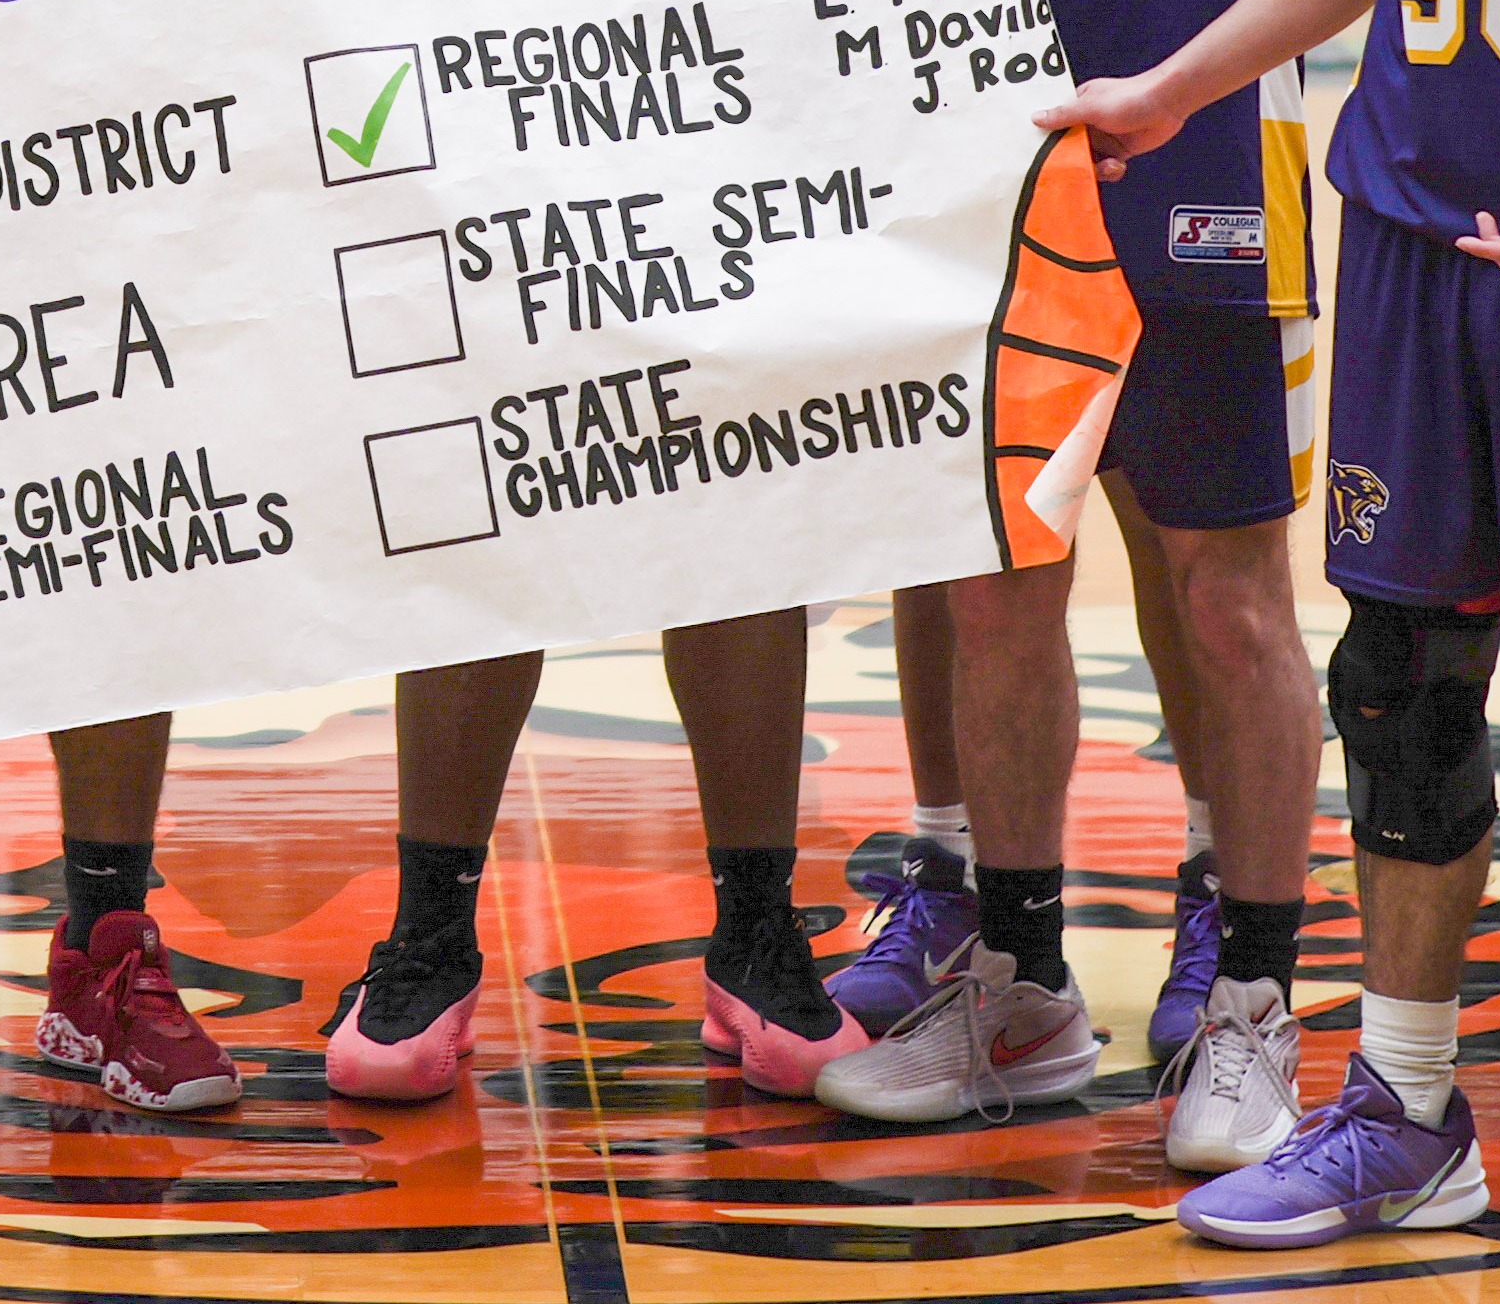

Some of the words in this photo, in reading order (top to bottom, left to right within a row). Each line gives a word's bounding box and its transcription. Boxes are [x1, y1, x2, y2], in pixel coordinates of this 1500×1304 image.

[433, 3, 743, 93] REGIONAL
[510, 64, 752, 151] FINALS
[455, 194, 674, 282] STATE
[712, 167, 892, 249] SEMI-
[517, 250, 755, 344] FINALS
[490, 359, 701, 461] STATE
[504, 373, 971, 518] CHAMPIONSHIPS
